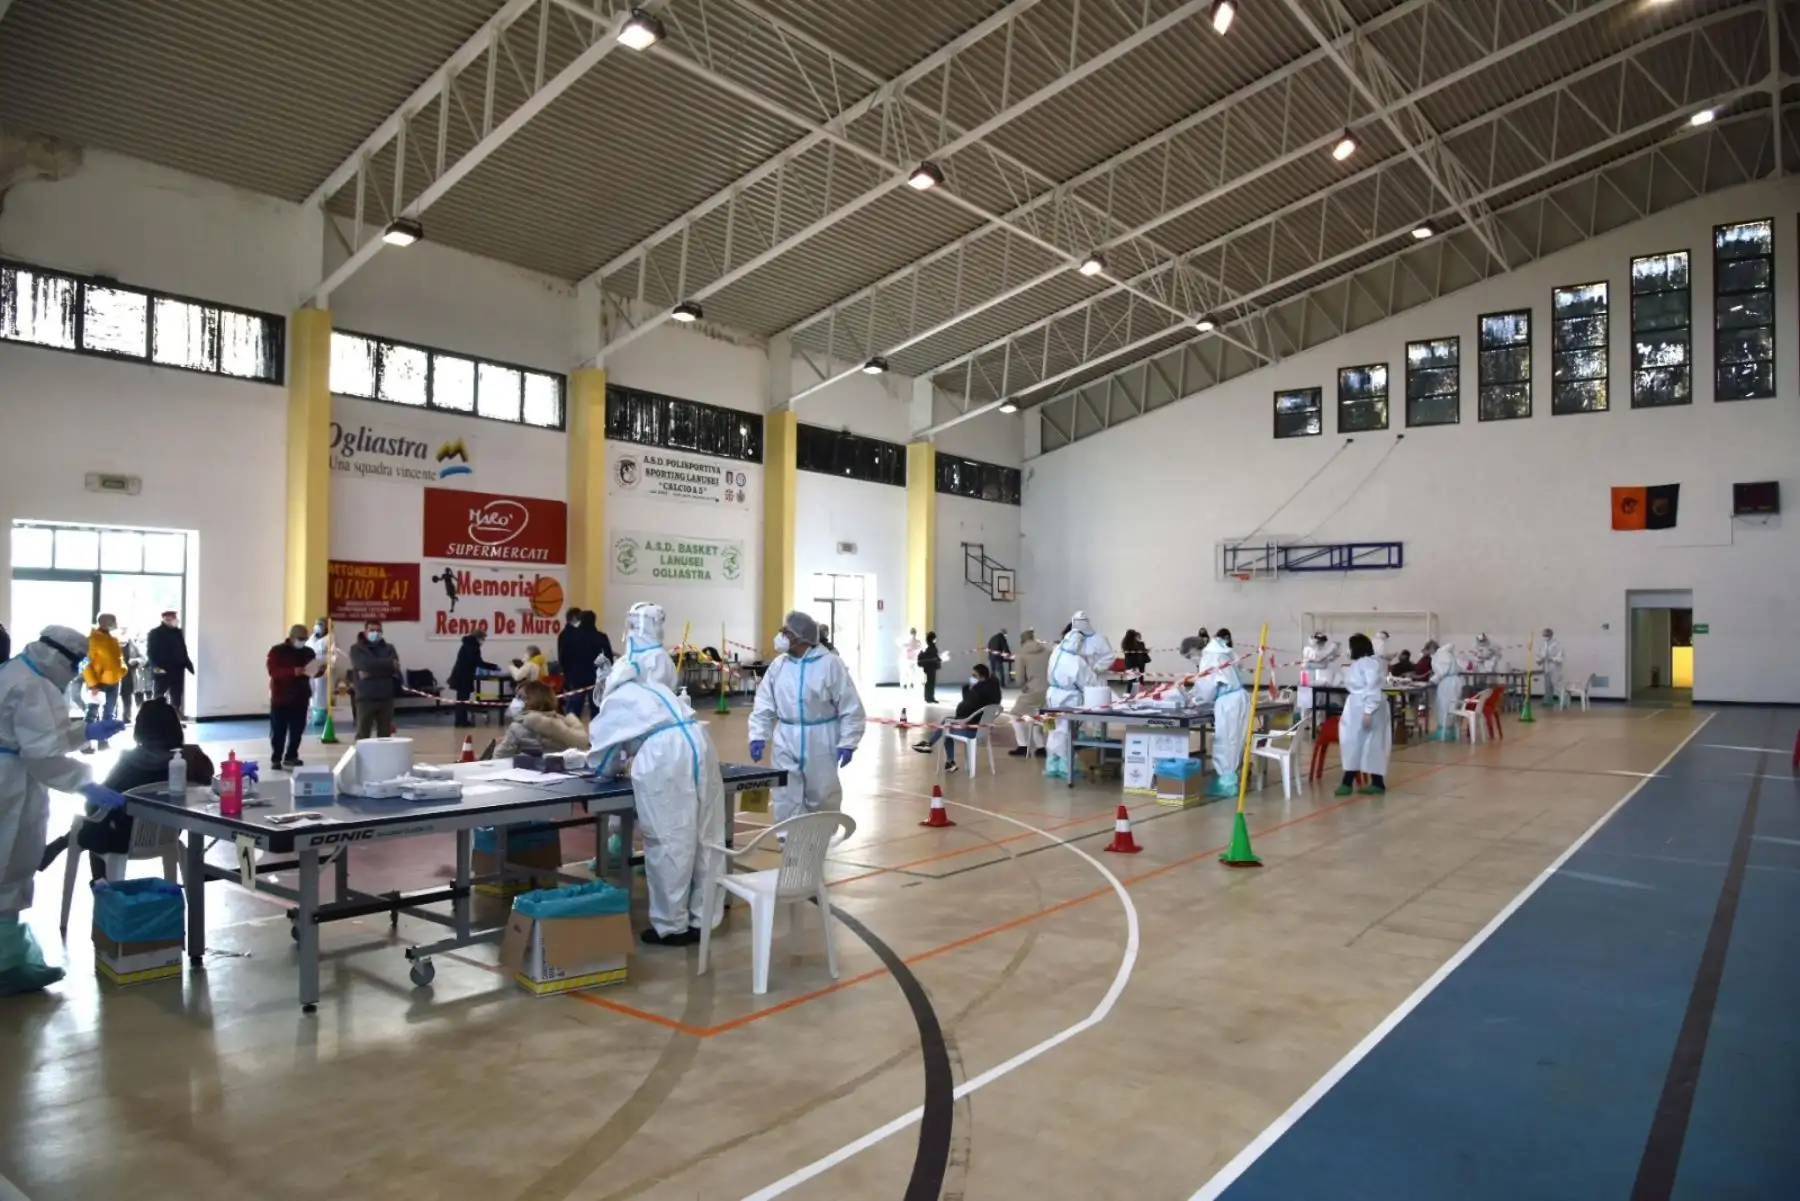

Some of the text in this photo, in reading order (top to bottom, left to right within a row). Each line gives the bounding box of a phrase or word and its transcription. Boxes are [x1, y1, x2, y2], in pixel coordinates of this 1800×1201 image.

[354, 461, 392, 477] squadra
[396, 466, 437, 481] vincente
[665, 459, 721, 475] POLISPORTIVA
[645, 468, 720, 486] SPORTING LANUSEI
[446, 542, 549, 561] SUPERMERCATI
[645, 541, 676, 553] A.S.D.
[678, 543, 719, 556] BASKET
[660, 555, 704, 567] LANUSEI
[652, 567, 712, 580] OGLIASTRA
[382, 579, 409, 600] LAI
[456, 571, 541, 597] Memorial
[435, 610, 561, 635] Renzo De Muro
[309, 829, 376, 847] DONIC
